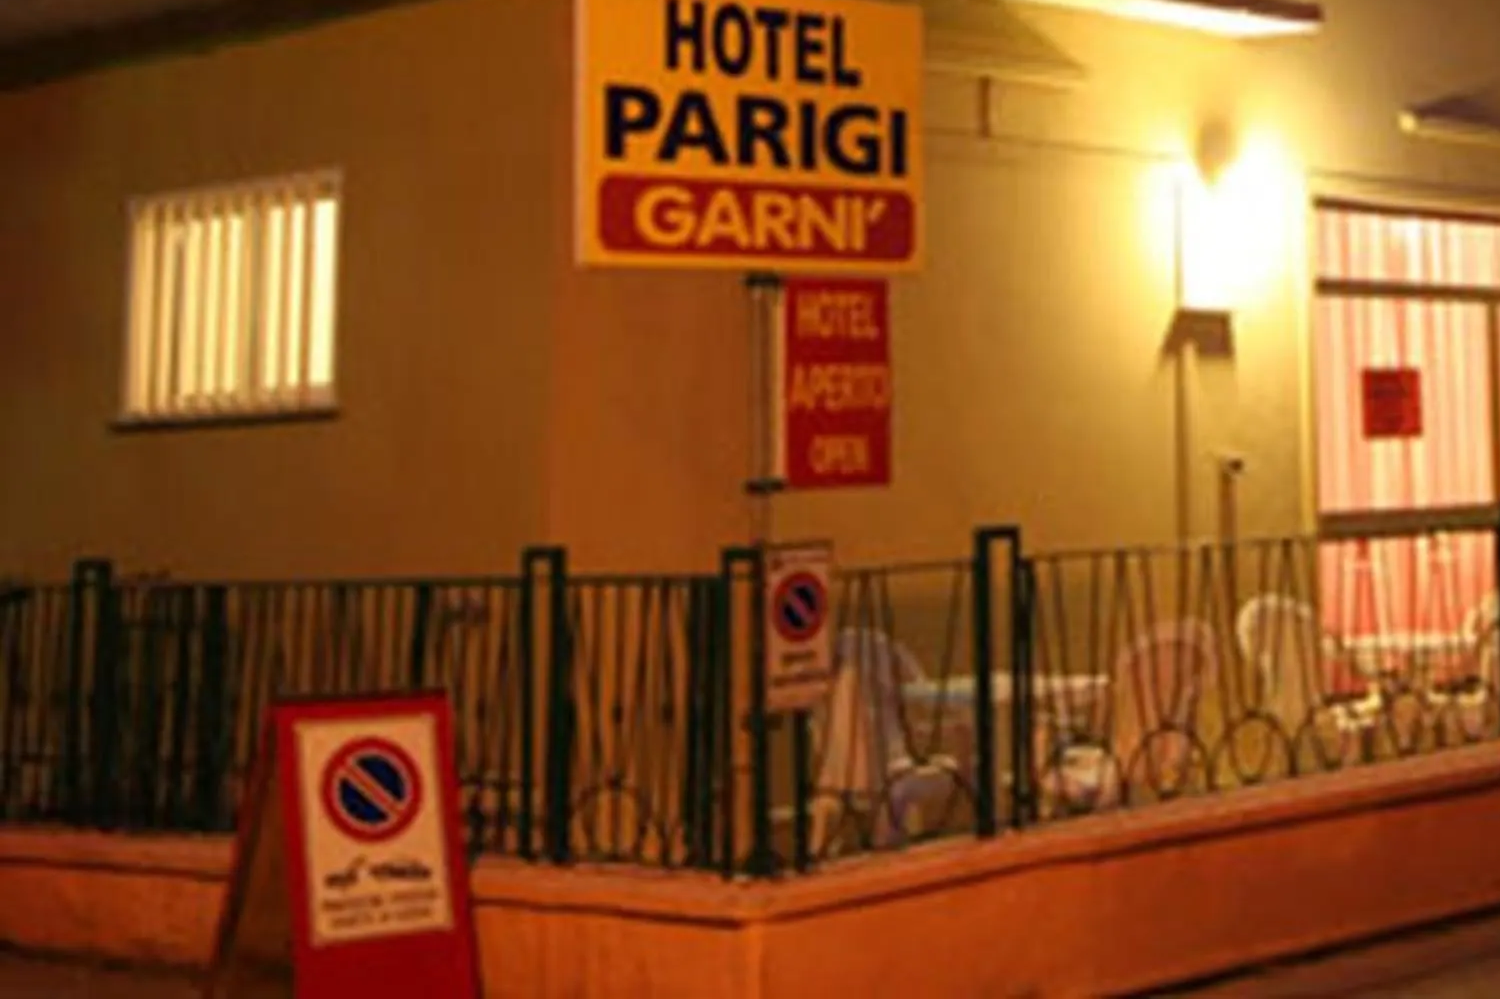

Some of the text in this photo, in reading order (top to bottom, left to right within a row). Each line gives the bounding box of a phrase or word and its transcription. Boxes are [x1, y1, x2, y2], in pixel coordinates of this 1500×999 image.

[604, 83, 909, 179] PARIGI
[796, 291, 880, 340] HOTEL
[790, 363, 889, 411] APERTO
[808, 434, 871, 475] OPEN
